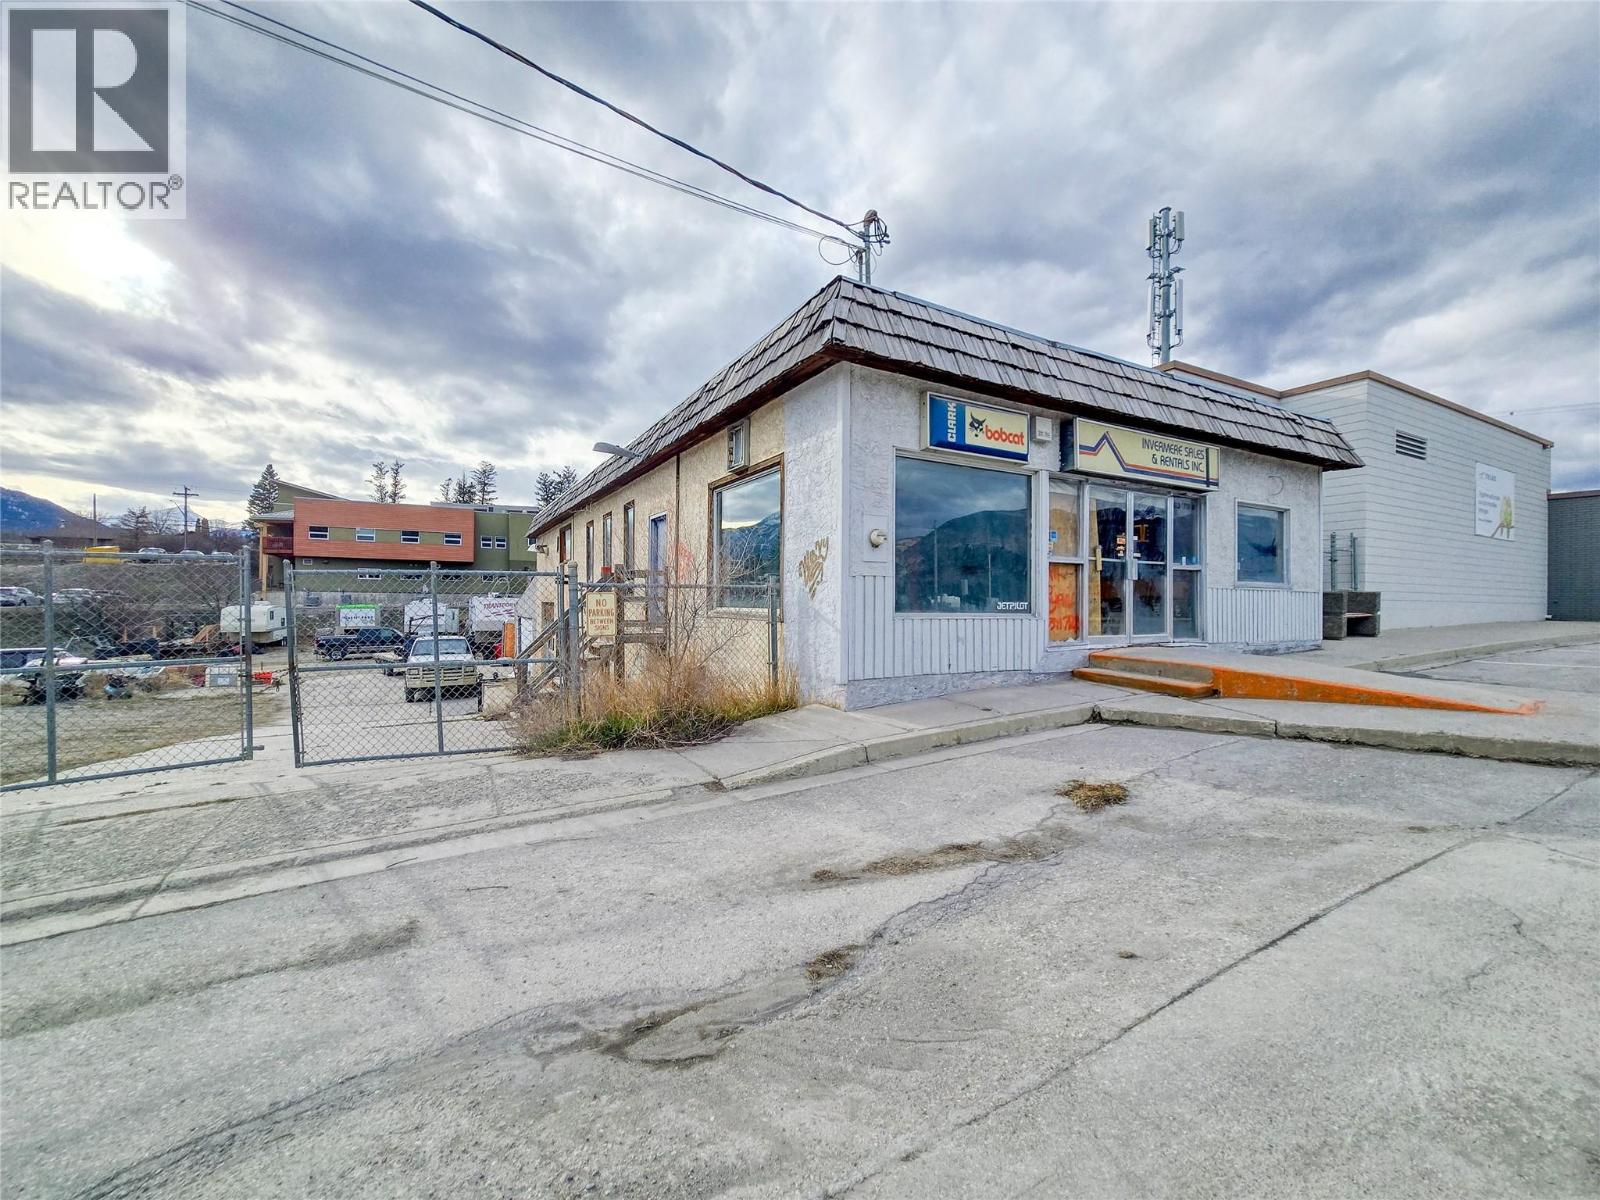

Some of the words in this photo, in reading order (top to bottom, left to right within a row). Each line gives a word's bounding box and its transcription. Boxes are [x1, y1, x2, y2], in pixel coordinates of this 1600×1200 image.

[947, 401, 957, 443] CLARK
[985, 424, 1025, 446] bobcat
[1141, 437, 1183, 456] INVERMERE
[1184, 446, 1205, 460] SALES
[1151, 453, 1158, 465] &
[1160, 455, 1190, 470] RENTALS
[1191, 460, 1205, 473] INC
[588, 608, 615, 617] PARKING
[595, 598, 607, 607] NO
[996, 601, 1029, 610] JETPILOT
